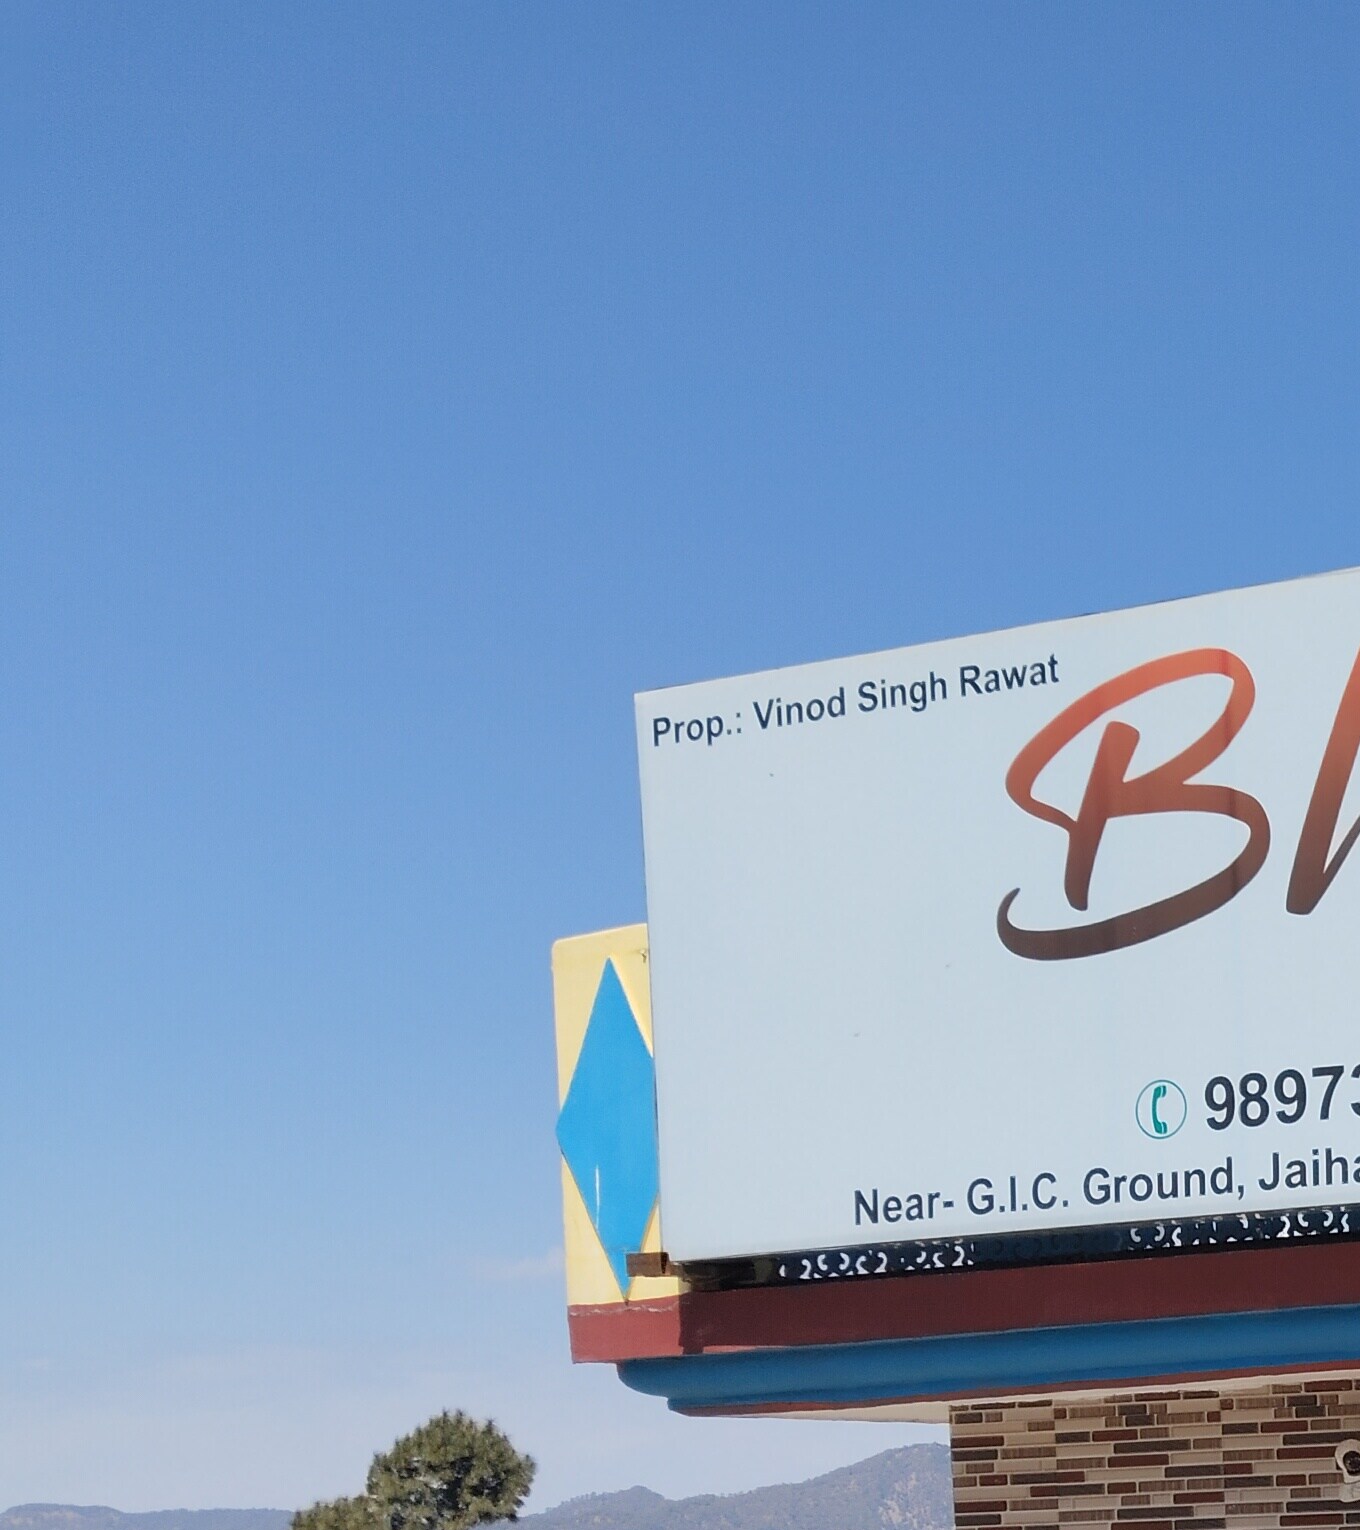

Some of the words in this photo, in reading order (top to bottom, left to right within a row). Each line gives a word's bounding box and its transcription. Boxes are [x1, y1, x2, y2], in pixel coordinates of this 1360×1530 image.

[653, 712, 743, 748] Prop.:
[752, 687, 847, 730] Vinod
[857, 671, 948, 713] Singh
[959, 654, 1060, 697] Rawat
[854, 1188, 954, 1226] Near-
[967, 1172, 1069, 1216] G.I.C.
[1083, 1156, 1245, 1205] Ground,
